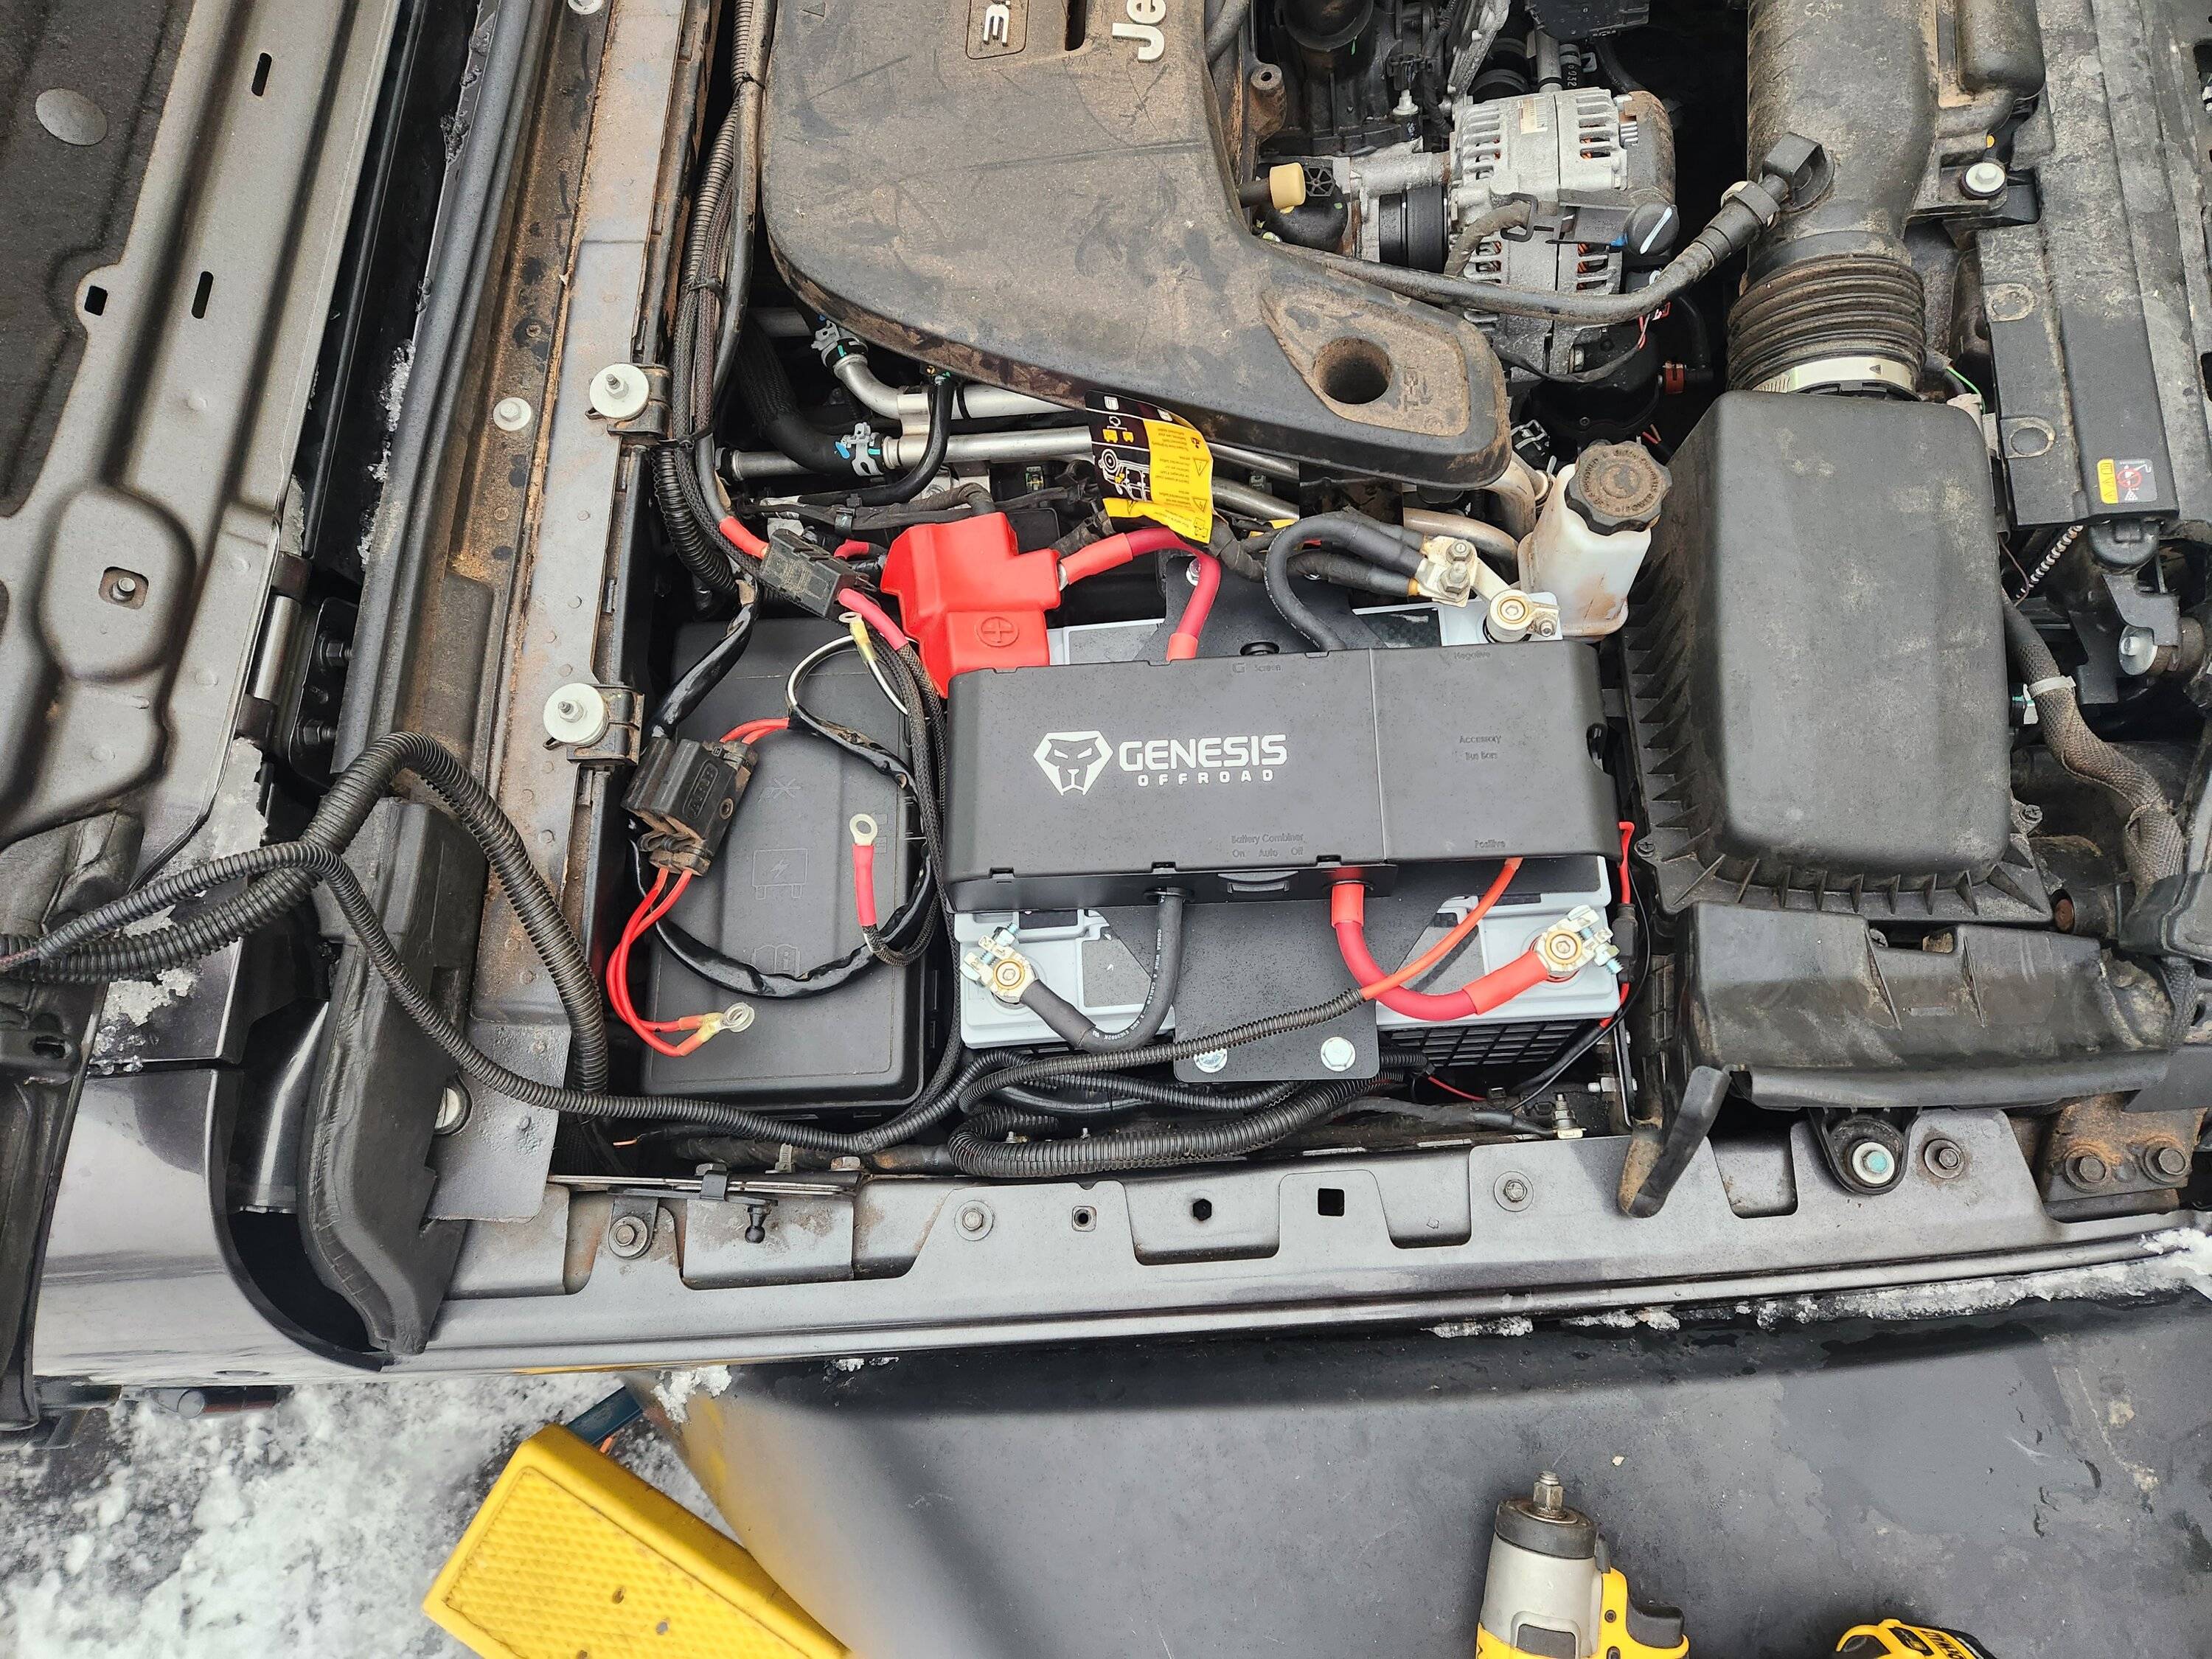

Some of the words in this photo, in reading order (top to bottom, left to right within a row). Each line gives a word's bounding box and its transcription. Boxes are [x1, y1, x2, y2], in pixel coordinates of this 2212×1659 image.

[1119, 734, 1288, 772] GENESIS
[1138, 769, 1274, 787] OFFROAD
[1262, 832, 1304, 843] Combiner
[1232, 849, 1245, 858] On
[1258, 847, 1279, 858] Auto
[1290, 846, 1304, 856] Off
